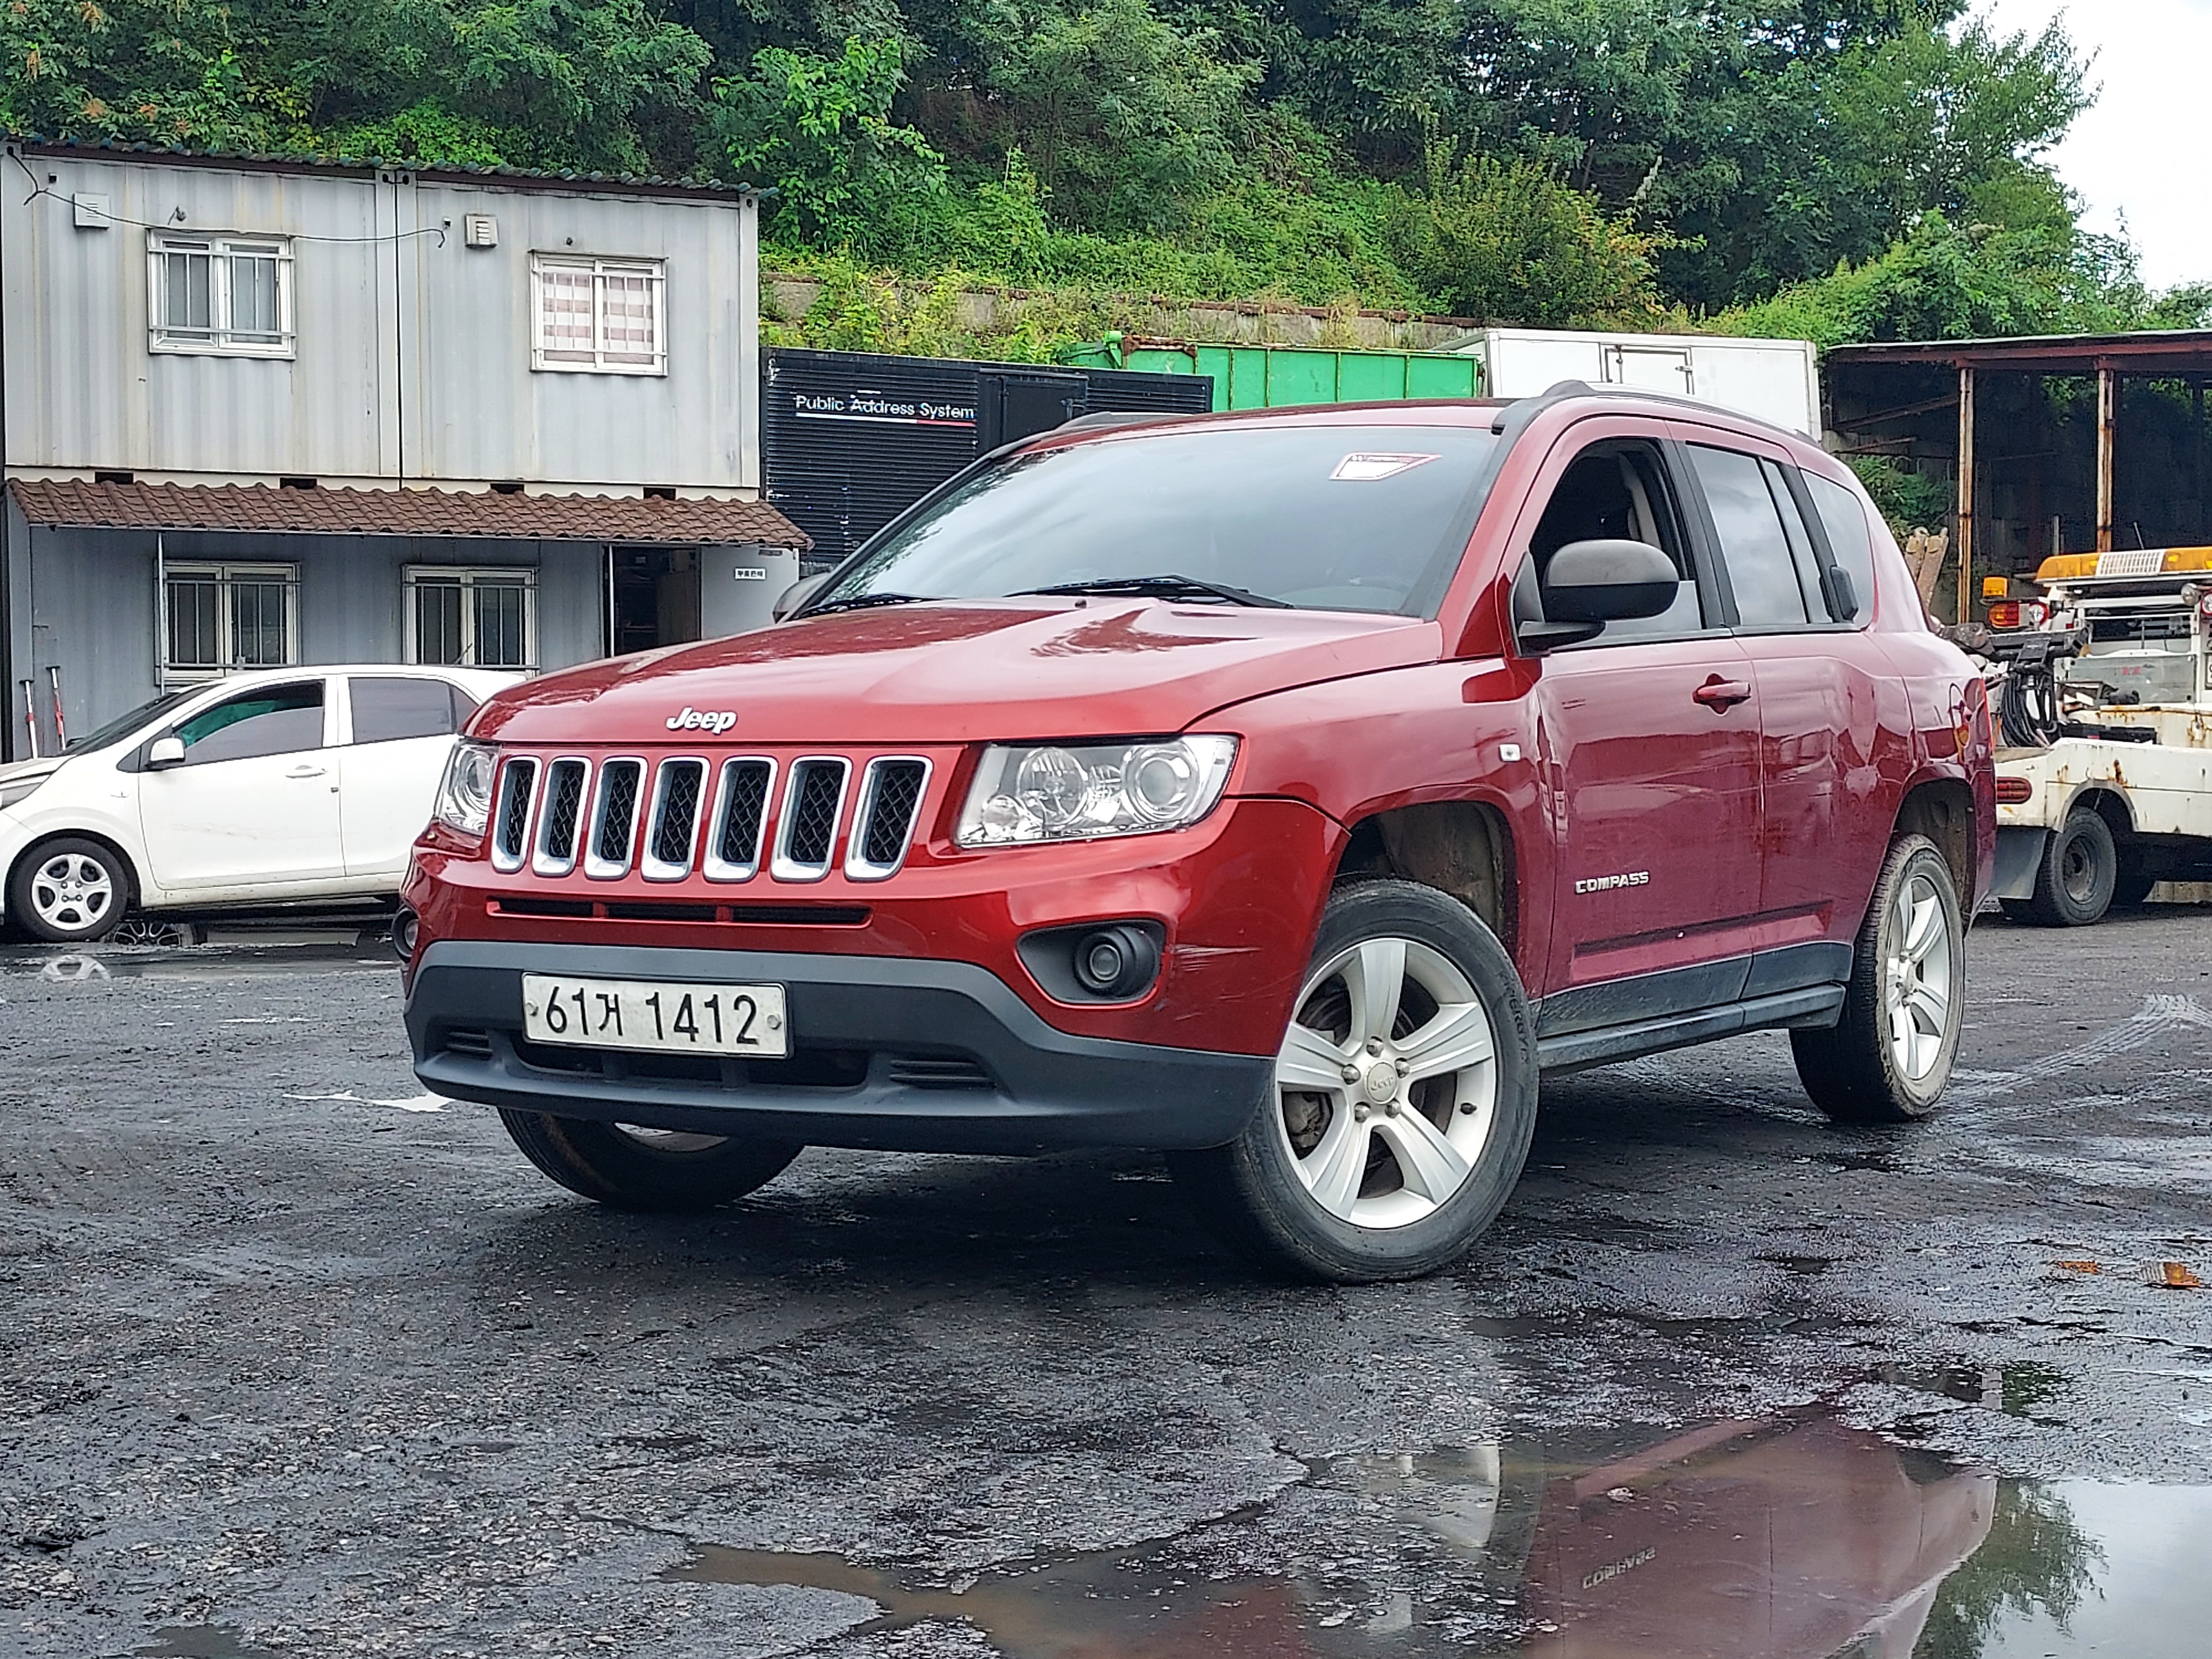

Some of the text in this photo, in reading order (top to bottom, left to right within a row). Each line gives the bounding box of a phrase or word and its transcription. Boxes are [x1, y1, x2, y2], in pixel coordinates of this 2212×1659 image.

[796, 394, 975, 420] Public Address System
[666, 707, 737, 734] Jeep
[1575, 871, 1650, 894] COMPASS
[546, 986, 759, 1045] 61거 1412
